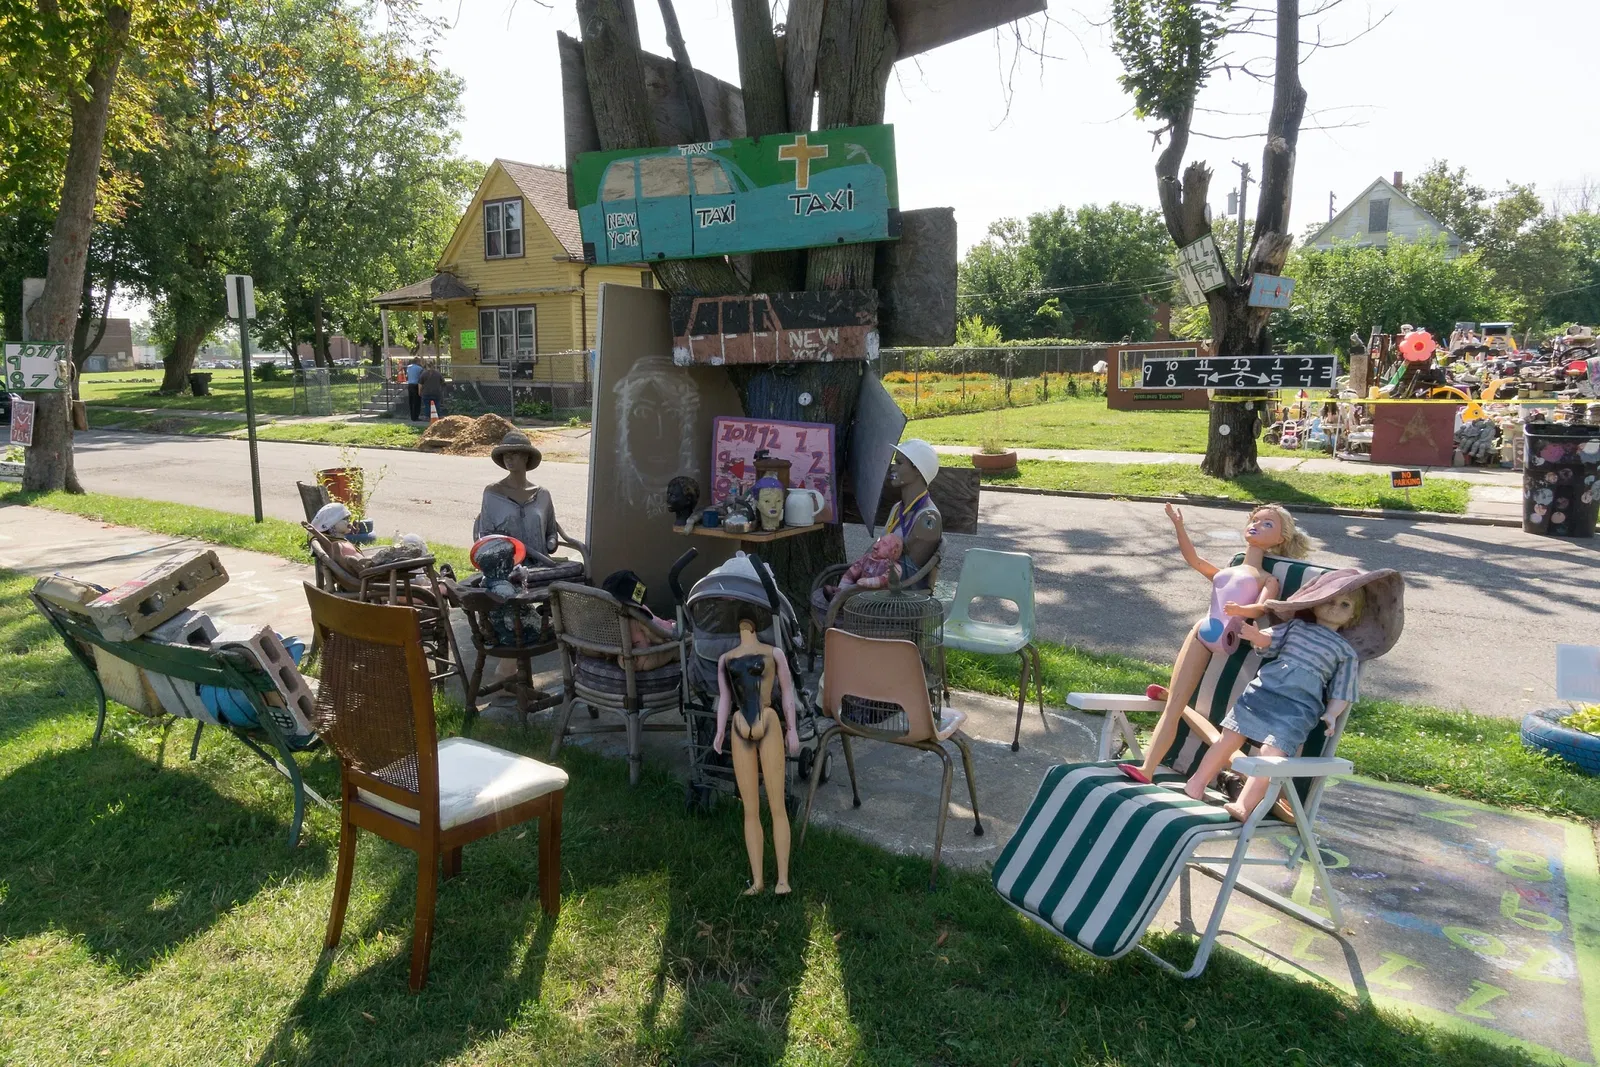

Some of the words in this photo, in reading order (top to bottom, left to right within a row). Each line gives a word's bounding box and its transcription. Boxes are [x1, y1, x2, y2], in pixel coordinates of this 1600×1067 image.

[607, 212, 636, 230] NEW
[789, 327, 838, 348] NEW
[7, 355, 21, 370] 9
[1165, 361, 1179, 371] 10
[1195, 359, 1213, 370] 11
[1231, 359, 1251, 371] 12
[1271, 358, 1284, 370] 1
[1299, 358, 1314, 371] 2
[10, 371, 26, 389] 8
[31, 374, 50, 388] 7
[1143, 365, 1153, 380] 9
[1320, 366, 1333, 379] 3
[1165, 373, 1177, 387] 8
[1197, 374, 1208, 387] 7
[1235, 374, 1245, 387] 6
[1269, 374, 1283, 387] 5
[1300, 374, 1312, 387] 4
[757, 425, 781, 450] 12
[795, 431, 808, 453] 1
[809, 451, 826, 474] 2
[716, 477, 731, 501] 8
[1393, 478, 1421, 486] PARKING
[1494, 848, 1553, 882] 8
[1500, 889, 1564, 932] 9
